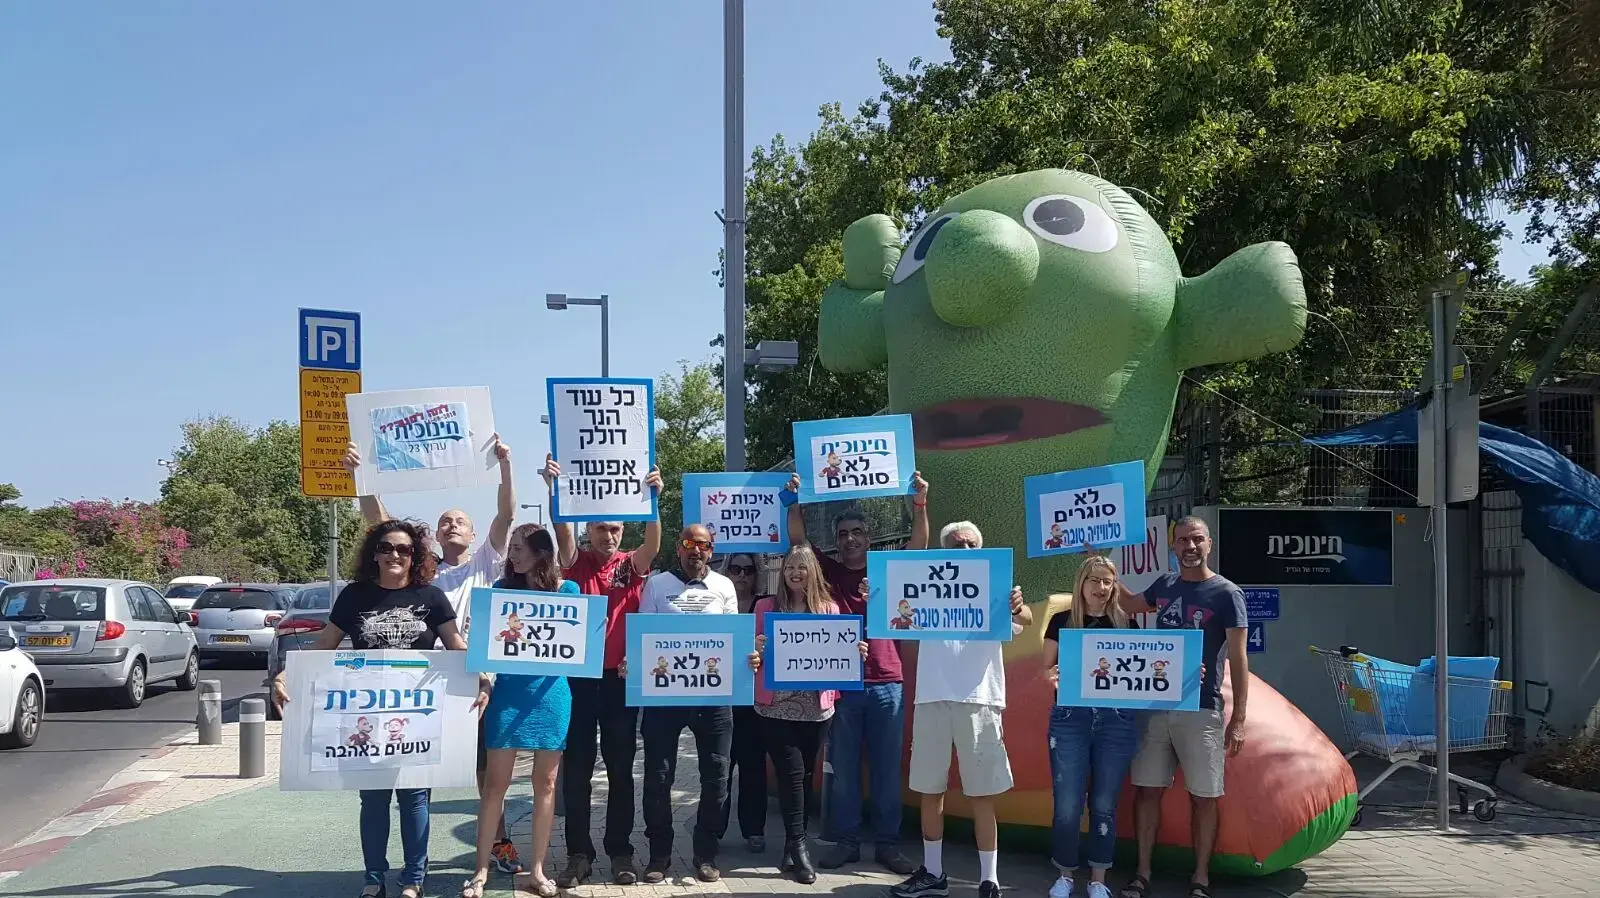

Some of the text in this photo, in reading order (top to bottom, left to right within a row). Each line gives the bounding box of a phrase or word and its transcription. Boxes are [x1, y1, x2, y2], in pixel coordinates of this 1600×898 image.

[312, 375, 349, 384] חניה בתשלום
[565, 386, 635, 406] כל עוד
[583, 409, 621, 425] הנר
[332, 424, 345, 432] חניה
[394, 420, 460, 440] חינוכית
[579, 425, 627, 450] דולק
[408, 442, 447, 454] ערוץ 23
[820, 438, 888, 456] חינוכית
[570, 460, 637, 476] אפשר
[845, 456, 870, 473] לא
[323, 471, 338, 479] לרכב
[827, 472, 890, 489] סוגרים
[318, 482, 333, 490] בלבד
[343, 482, 348, 490] 4
[568, 476, 642, 500] לתקן!!!
[707, 490, 775, 505] איכות לא
[1074, 488, 1099, 506] לא
[720, 508, 761, 523] קונים
[1054, 503, 1117, 523] סוגרים
[719, 525, 763, 541] בכסף
[1063, 519, 1121, 546] טלוויזיה טובה
[1266, 535, 1343, 555] חינוכית
[928, 561, 960, 581] לא
[903, 583, 979, 599] סוגרים
[500, 601, 578, 619] חינוכית
[913, 603, 984, 629] טלוויזיה טובה
[526, 622, 556, 641] לא
[779, 628, 857, 644] לא לחיסול
[1249, 627, 1262, 646] 4
[503, 641, 576, 659] סוגרים
[655, 639, 725, 649] טלוויזיה טובה
[1096, 640, 1175, 651] טלוויזיה טובה
[673, 652, 701, 670] לא
[786, 658, 851, 671] החינוכית
[1115, 654, 1146, 672] לא
[655, 674, 722, 688] סוגרים
[1095, 675, 1170, 692] סוגרים
[323, 688, 435, 711] חינוכית
[325, 740, 431, 759] עושים באהבה
